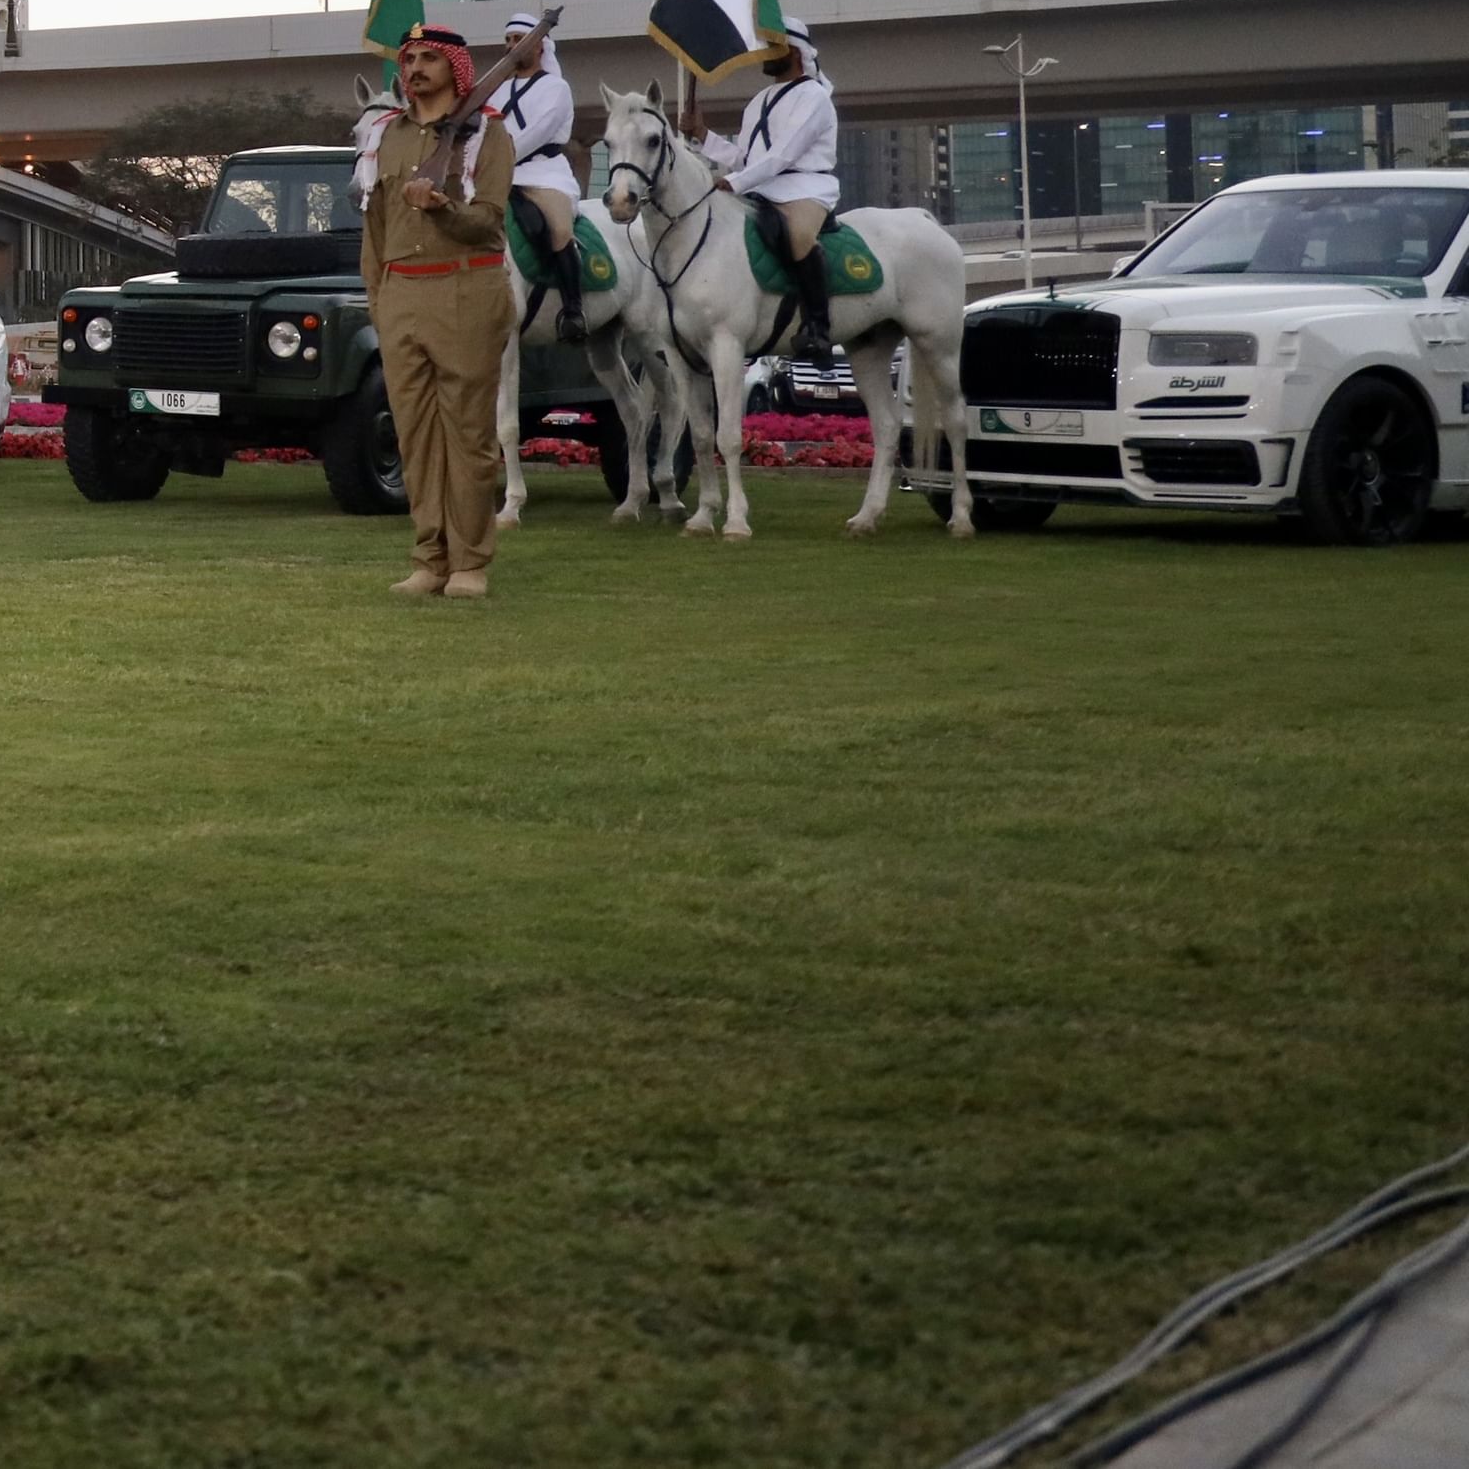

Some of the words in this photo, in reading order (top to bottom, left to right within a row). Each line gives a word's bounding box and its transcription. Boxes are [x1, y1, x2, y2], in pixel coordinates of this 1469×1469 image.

[1169, 376, 1226, 392] الشرطة
[161, 393, 186, 408] 1066
[1023, 412, 1031, 427] 9
